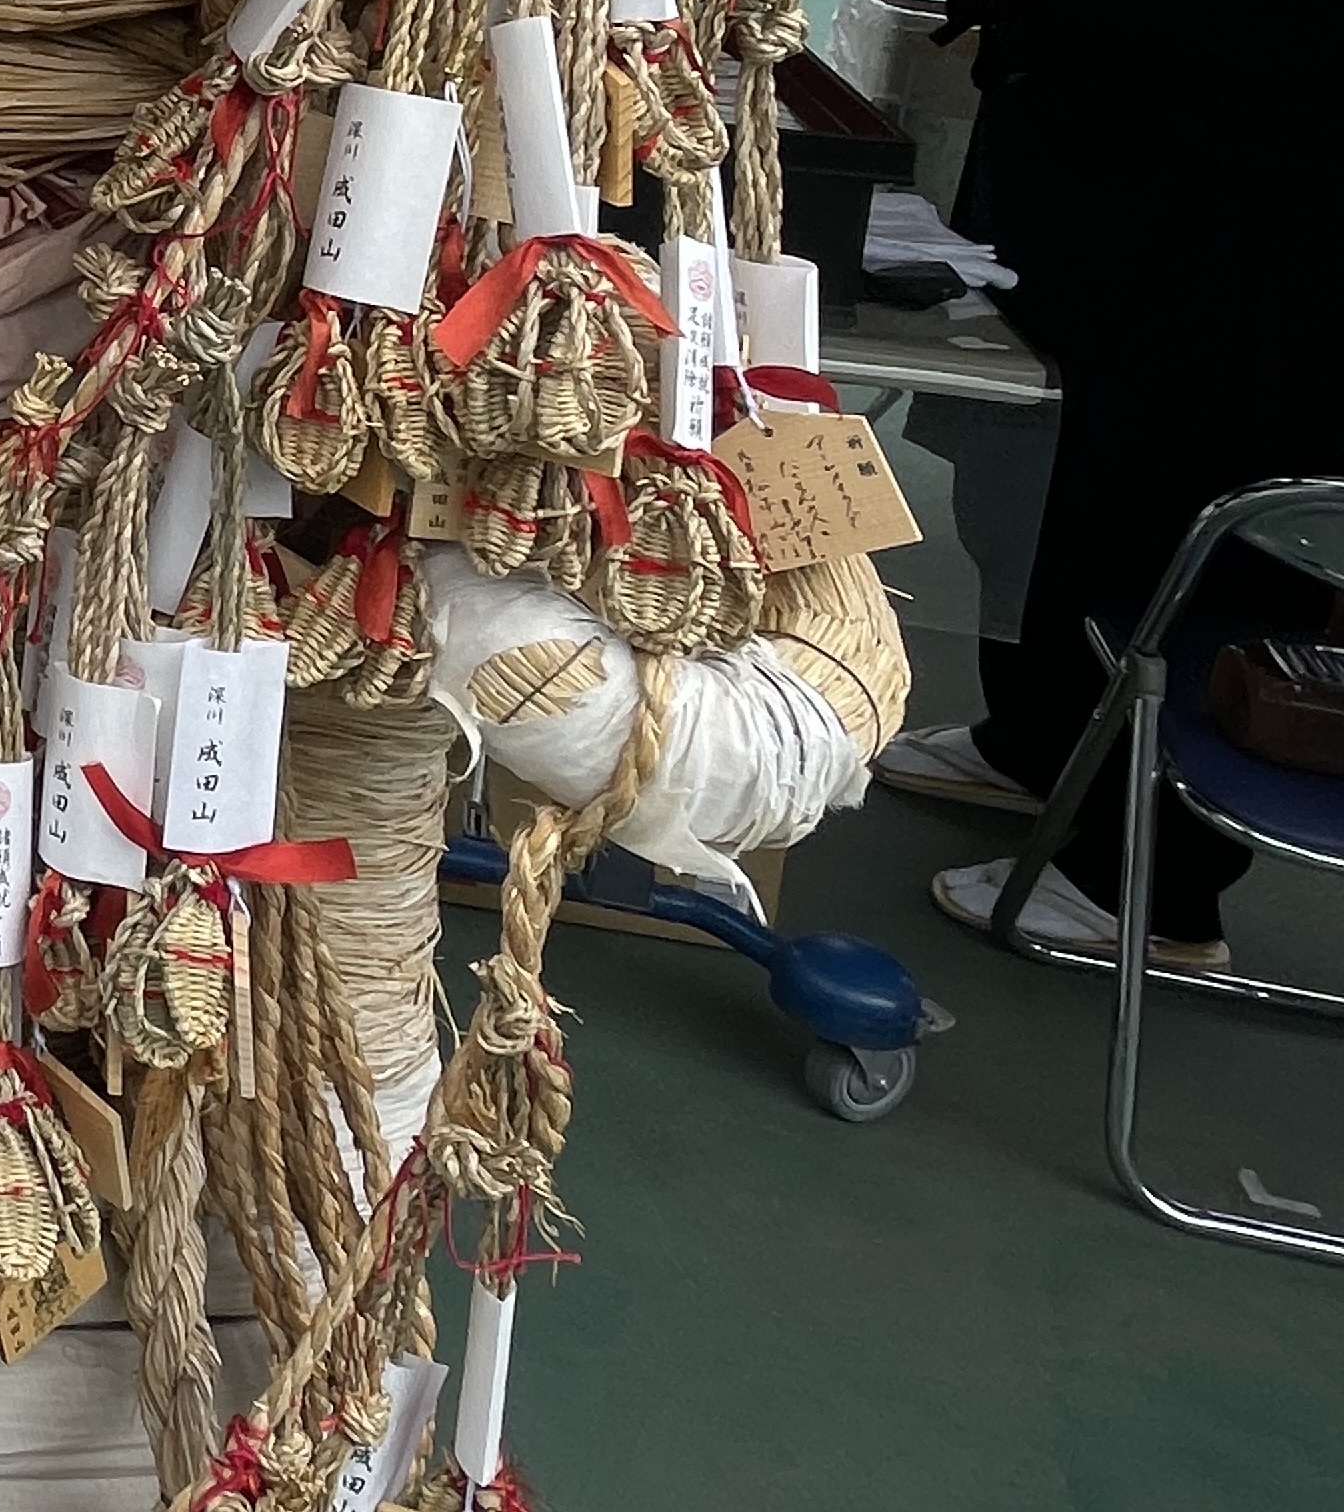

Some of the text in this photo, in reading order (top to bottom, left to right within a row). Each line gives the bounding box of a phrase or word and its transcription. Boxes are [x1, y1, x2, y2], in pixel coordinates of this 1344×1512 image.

[320, 175, 353, 260] 成田山
[48, 763, 71, 843] 成田山
[192, 740, 221, 822] 成田山
